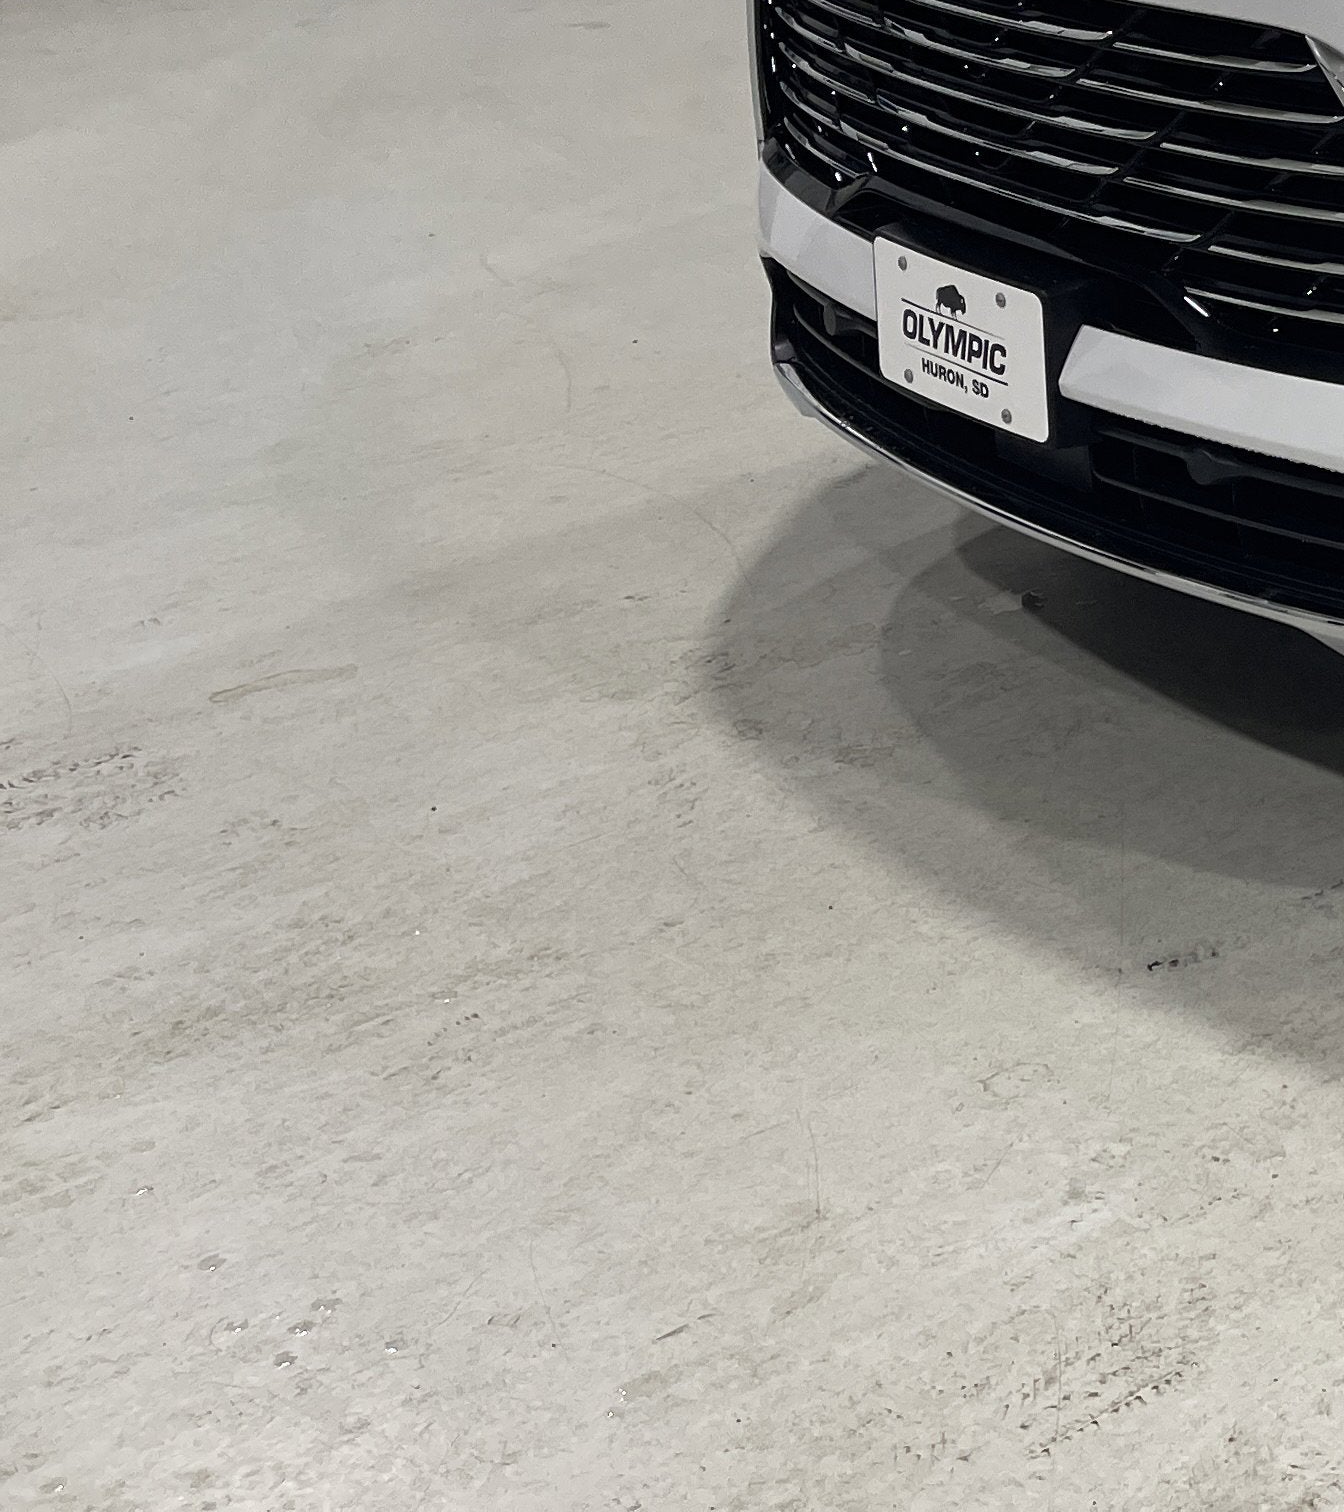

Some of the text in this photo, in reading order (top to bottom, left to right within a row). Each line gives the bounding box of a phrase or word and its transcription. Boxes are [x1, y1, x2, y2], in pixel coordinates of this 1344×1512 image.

[902, 309, 1007, 376] OLYMPIC
[922, 357, 990, 399] HURON, SD
